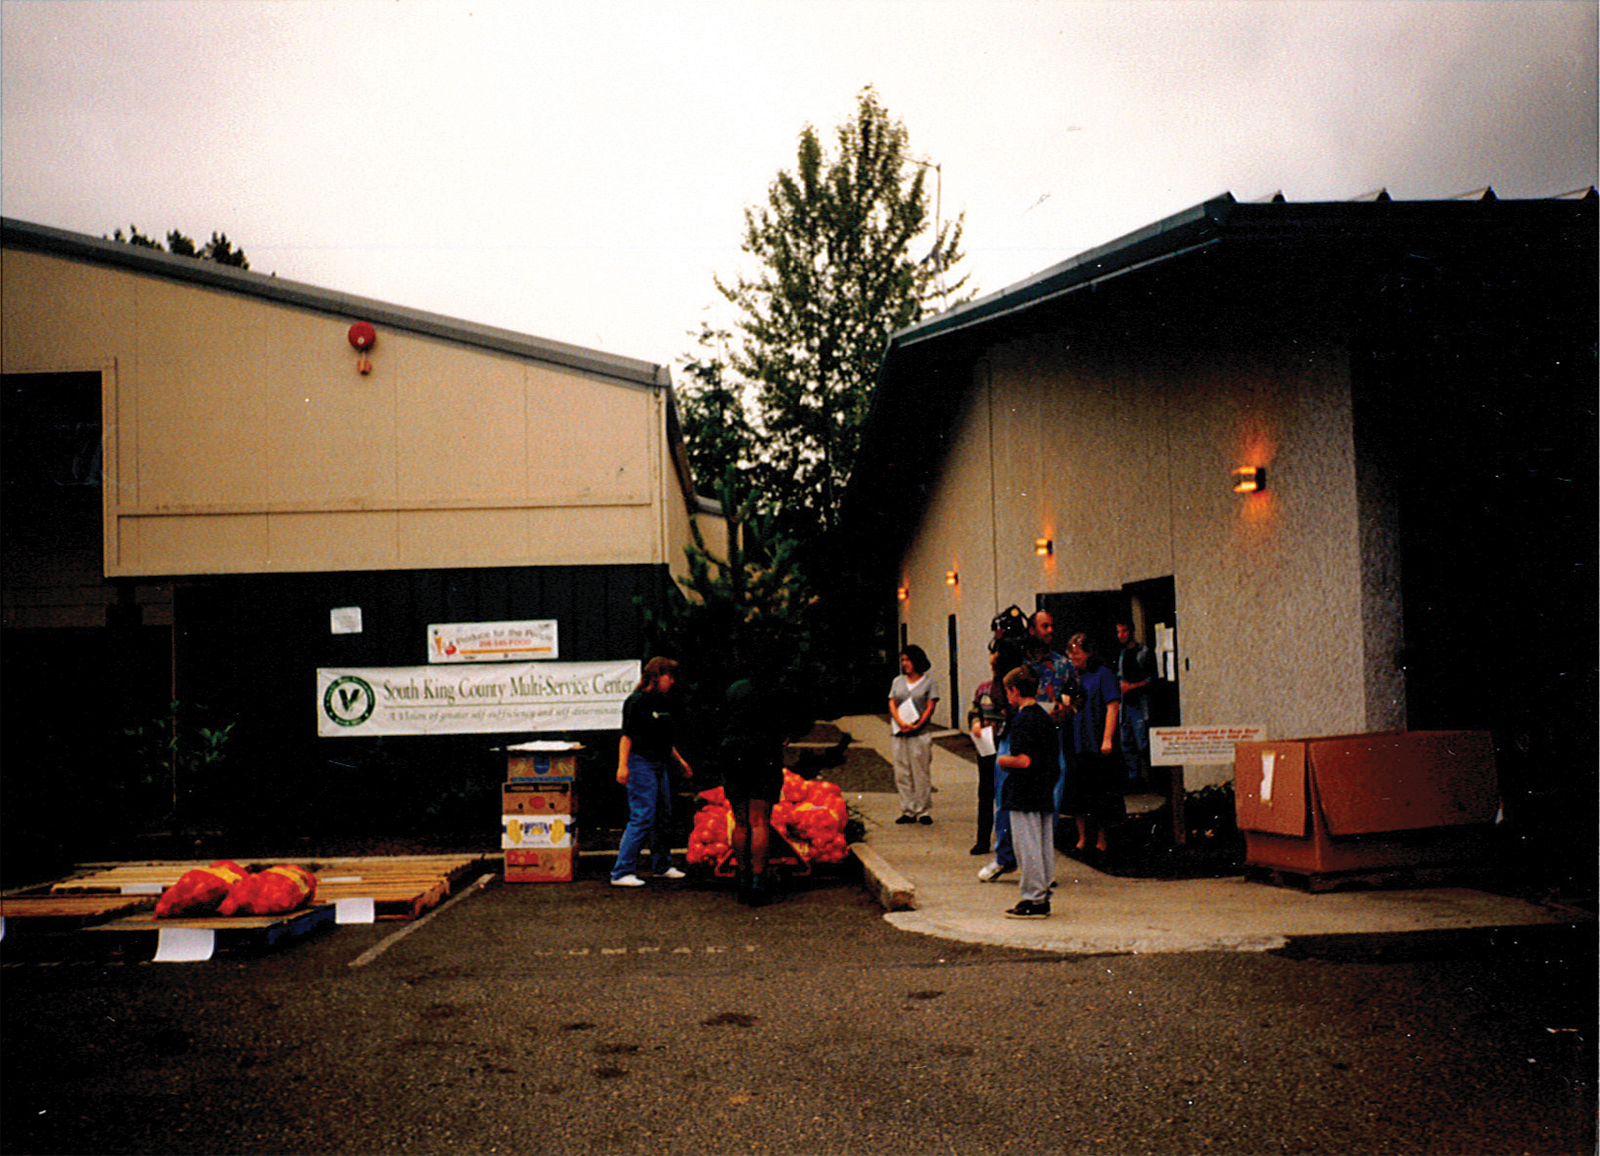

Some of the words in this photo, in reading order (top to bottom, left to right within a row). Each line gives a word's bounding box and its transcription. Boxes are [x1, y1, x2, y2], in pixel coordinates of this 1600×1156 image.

[384, 678, 420, 700] South
[423, 678, 456, 704] King
[458, 677, 506, 704] County
[510, 675, 589, 697] Multi-Service
[592, 673, 635, 694] Center
